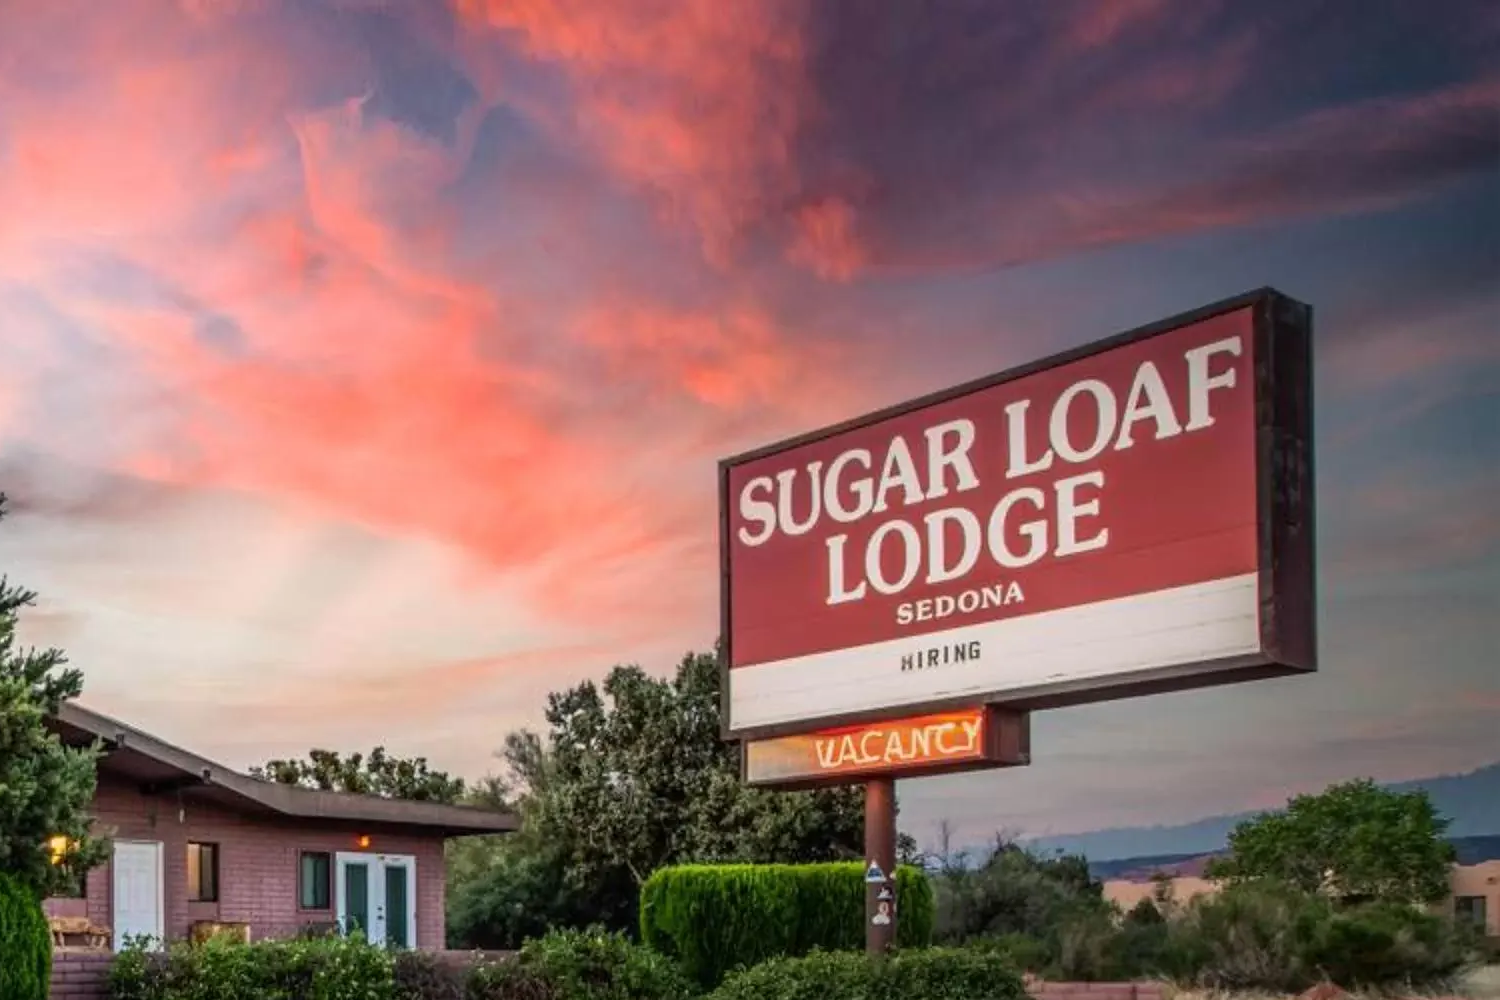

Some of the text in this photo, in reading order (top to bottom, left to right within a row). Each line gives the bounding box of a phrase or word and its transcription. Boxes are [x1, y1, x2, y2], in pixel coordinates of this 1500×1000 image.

[738, 337, 1242, 547] SUGAR LOAF
[825, 471, 1109, 605] LODGE
[896, 580, 1025, 625] SEDONA
[900, 640, 982, 672] HIRING
[815, 717, 982, 769] VACANCY
